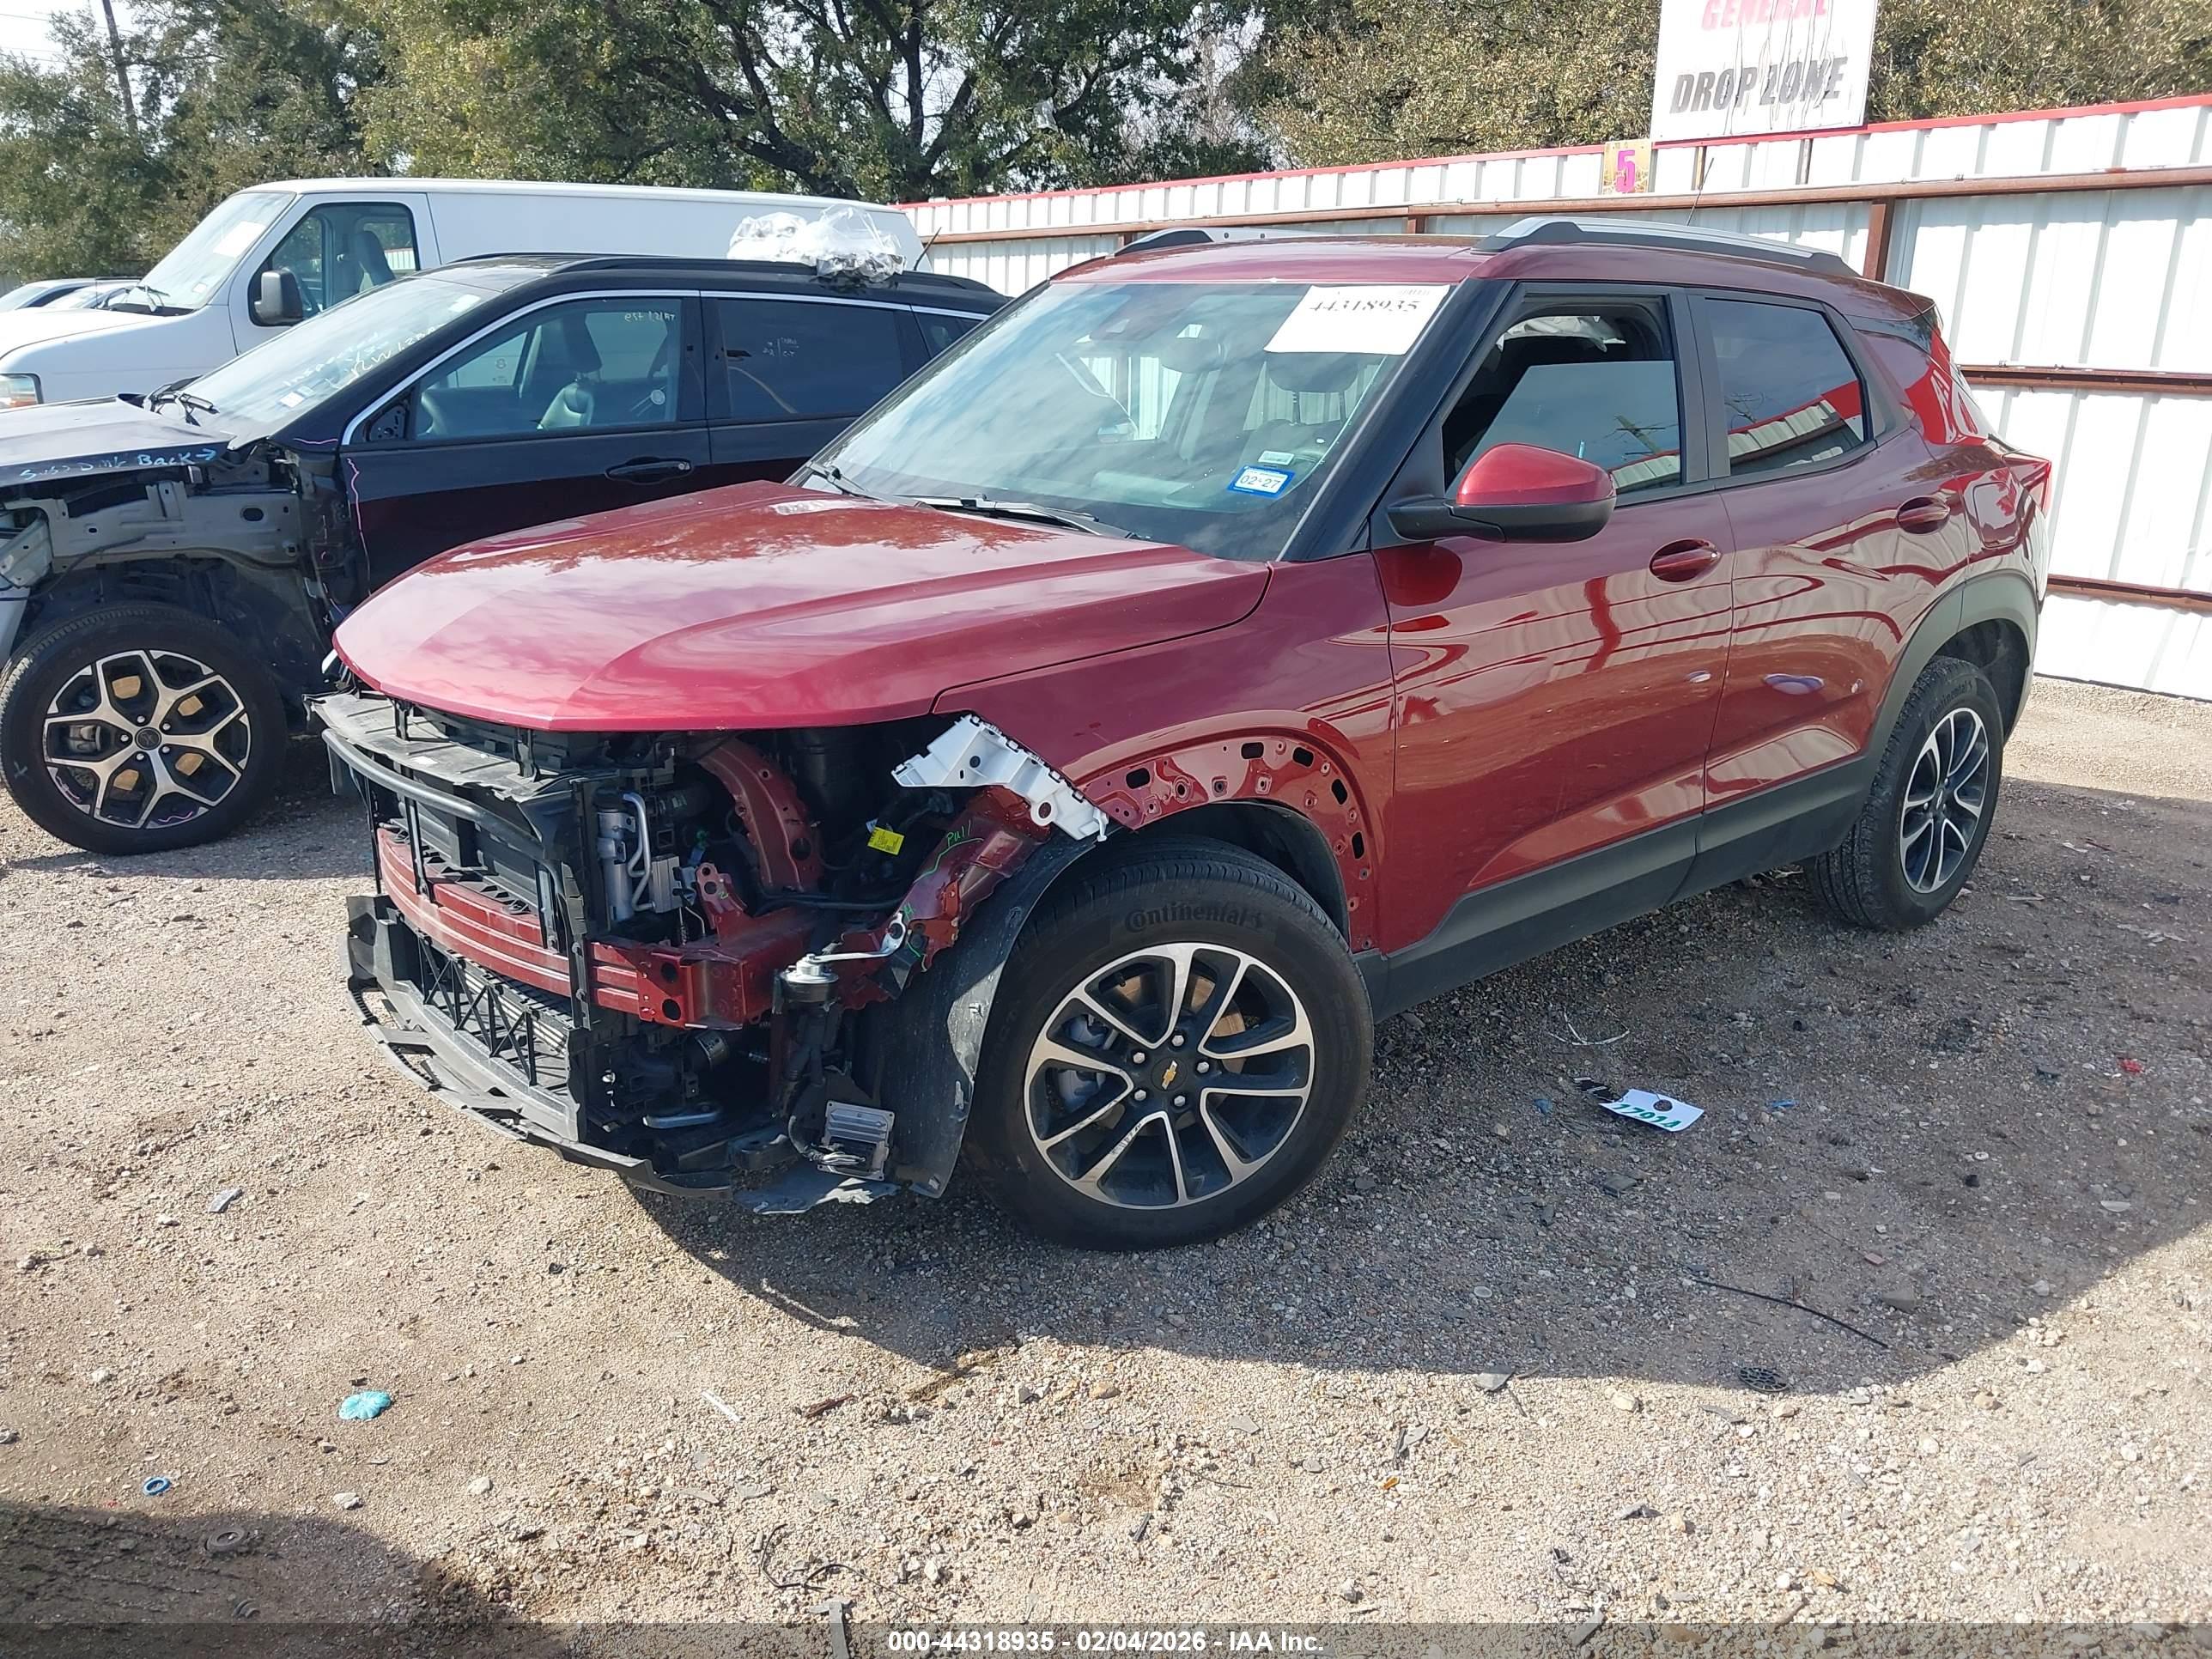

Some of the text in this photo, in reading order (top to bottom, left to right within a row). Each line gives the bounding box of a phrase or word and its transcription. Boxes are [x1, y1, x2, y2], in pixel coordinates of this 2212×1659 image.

[1669, 67, 1758, 114] DROP
[1615, 149, 1635, 193] 5
[1125, 901, 1246, 933] Continental
